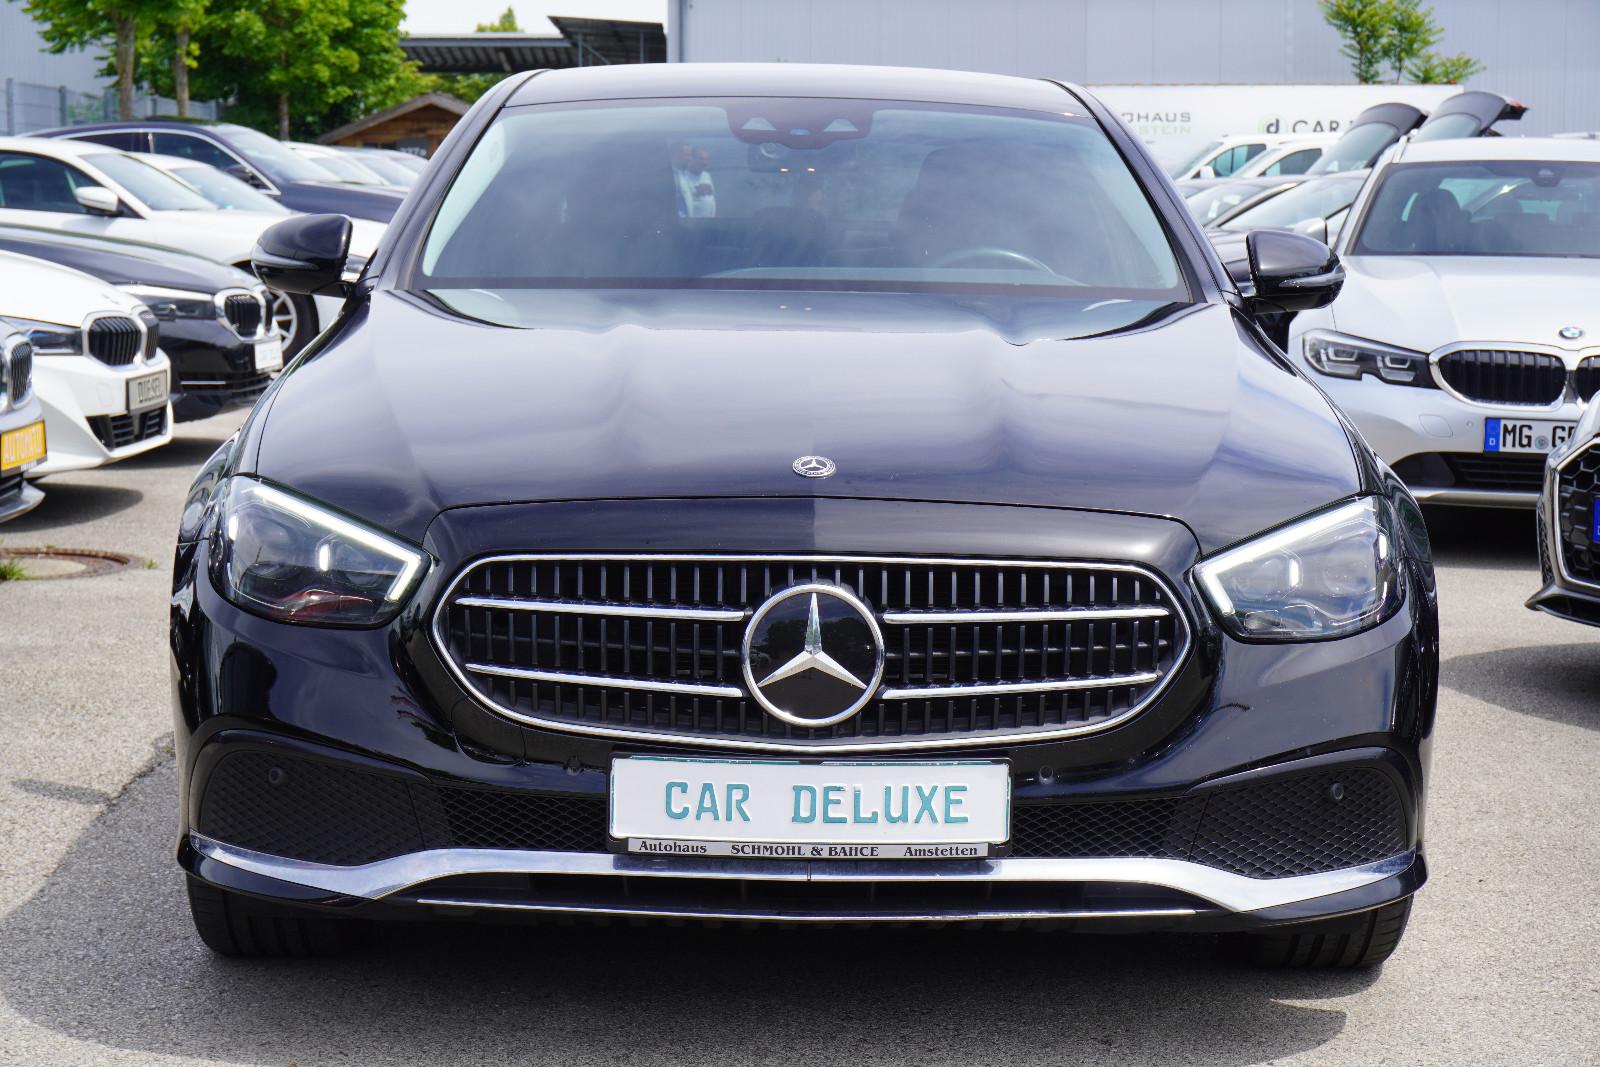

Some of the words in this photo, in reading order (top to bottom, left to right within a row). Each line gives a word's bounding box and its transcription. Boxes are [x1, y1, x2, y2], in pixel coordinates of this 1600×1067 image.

[1291, 120, 1340, 133] CAR
[1502, 423, 1533, 448] MG
[665, 781, 751, 822] CAR
[791, 784, 970, 824] DELUXE
[638, 840, 708, 854] Autohaus
[730, 843, 806, 856] SCHMOHL
[810, 845, 824, 857] &
[903, 845, 979, 857] Amstetten
